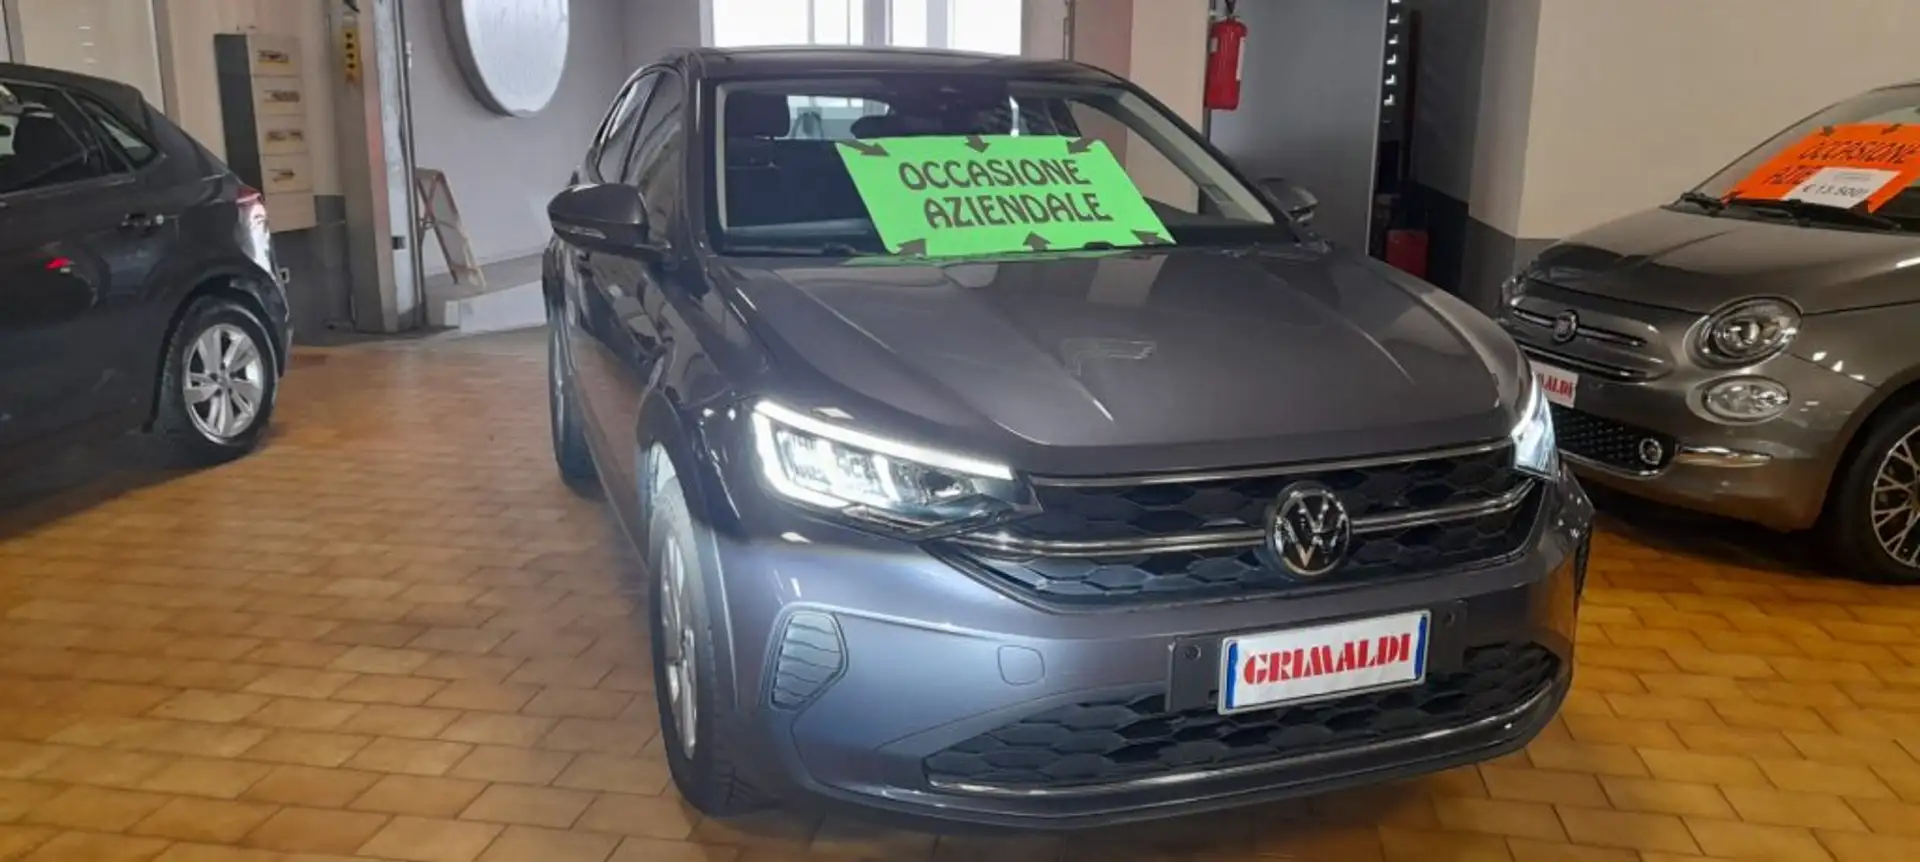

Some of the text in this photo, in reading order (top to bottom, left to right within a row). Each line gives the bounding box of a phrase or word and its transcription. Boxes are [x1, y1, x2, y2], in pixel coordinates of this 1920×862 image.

[898, 158, 1092, 191] OCCASIONE
[923, 192, 1113, 229] AZIENDALE
[1243, 633, 1411, 685] GRIMALDI
